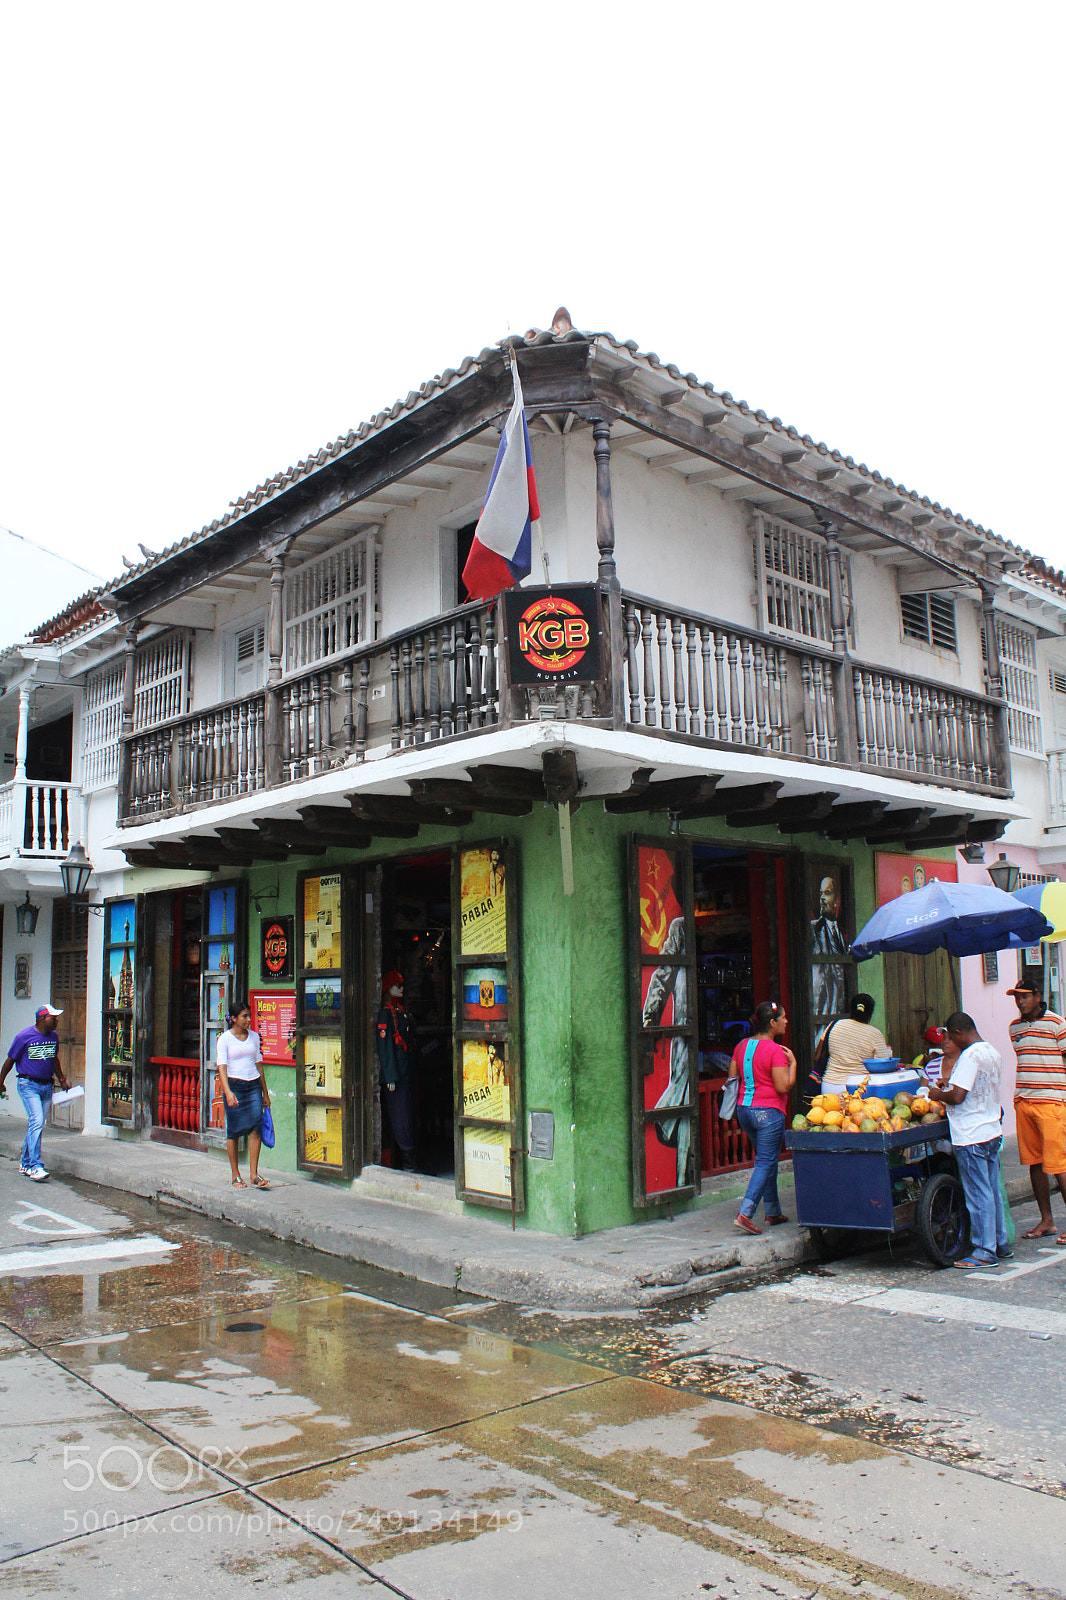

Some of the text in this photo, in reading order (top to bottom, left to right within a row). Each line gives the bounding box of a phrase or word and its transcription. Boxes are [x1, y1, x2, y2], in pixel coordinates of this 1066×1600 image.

[518, 618, 590, 652] KGB
[536, 670, 579, 681] RUSSIA
[460, 898, 494, 927] РАВДА
[264, 937, 288, 959] KGB
